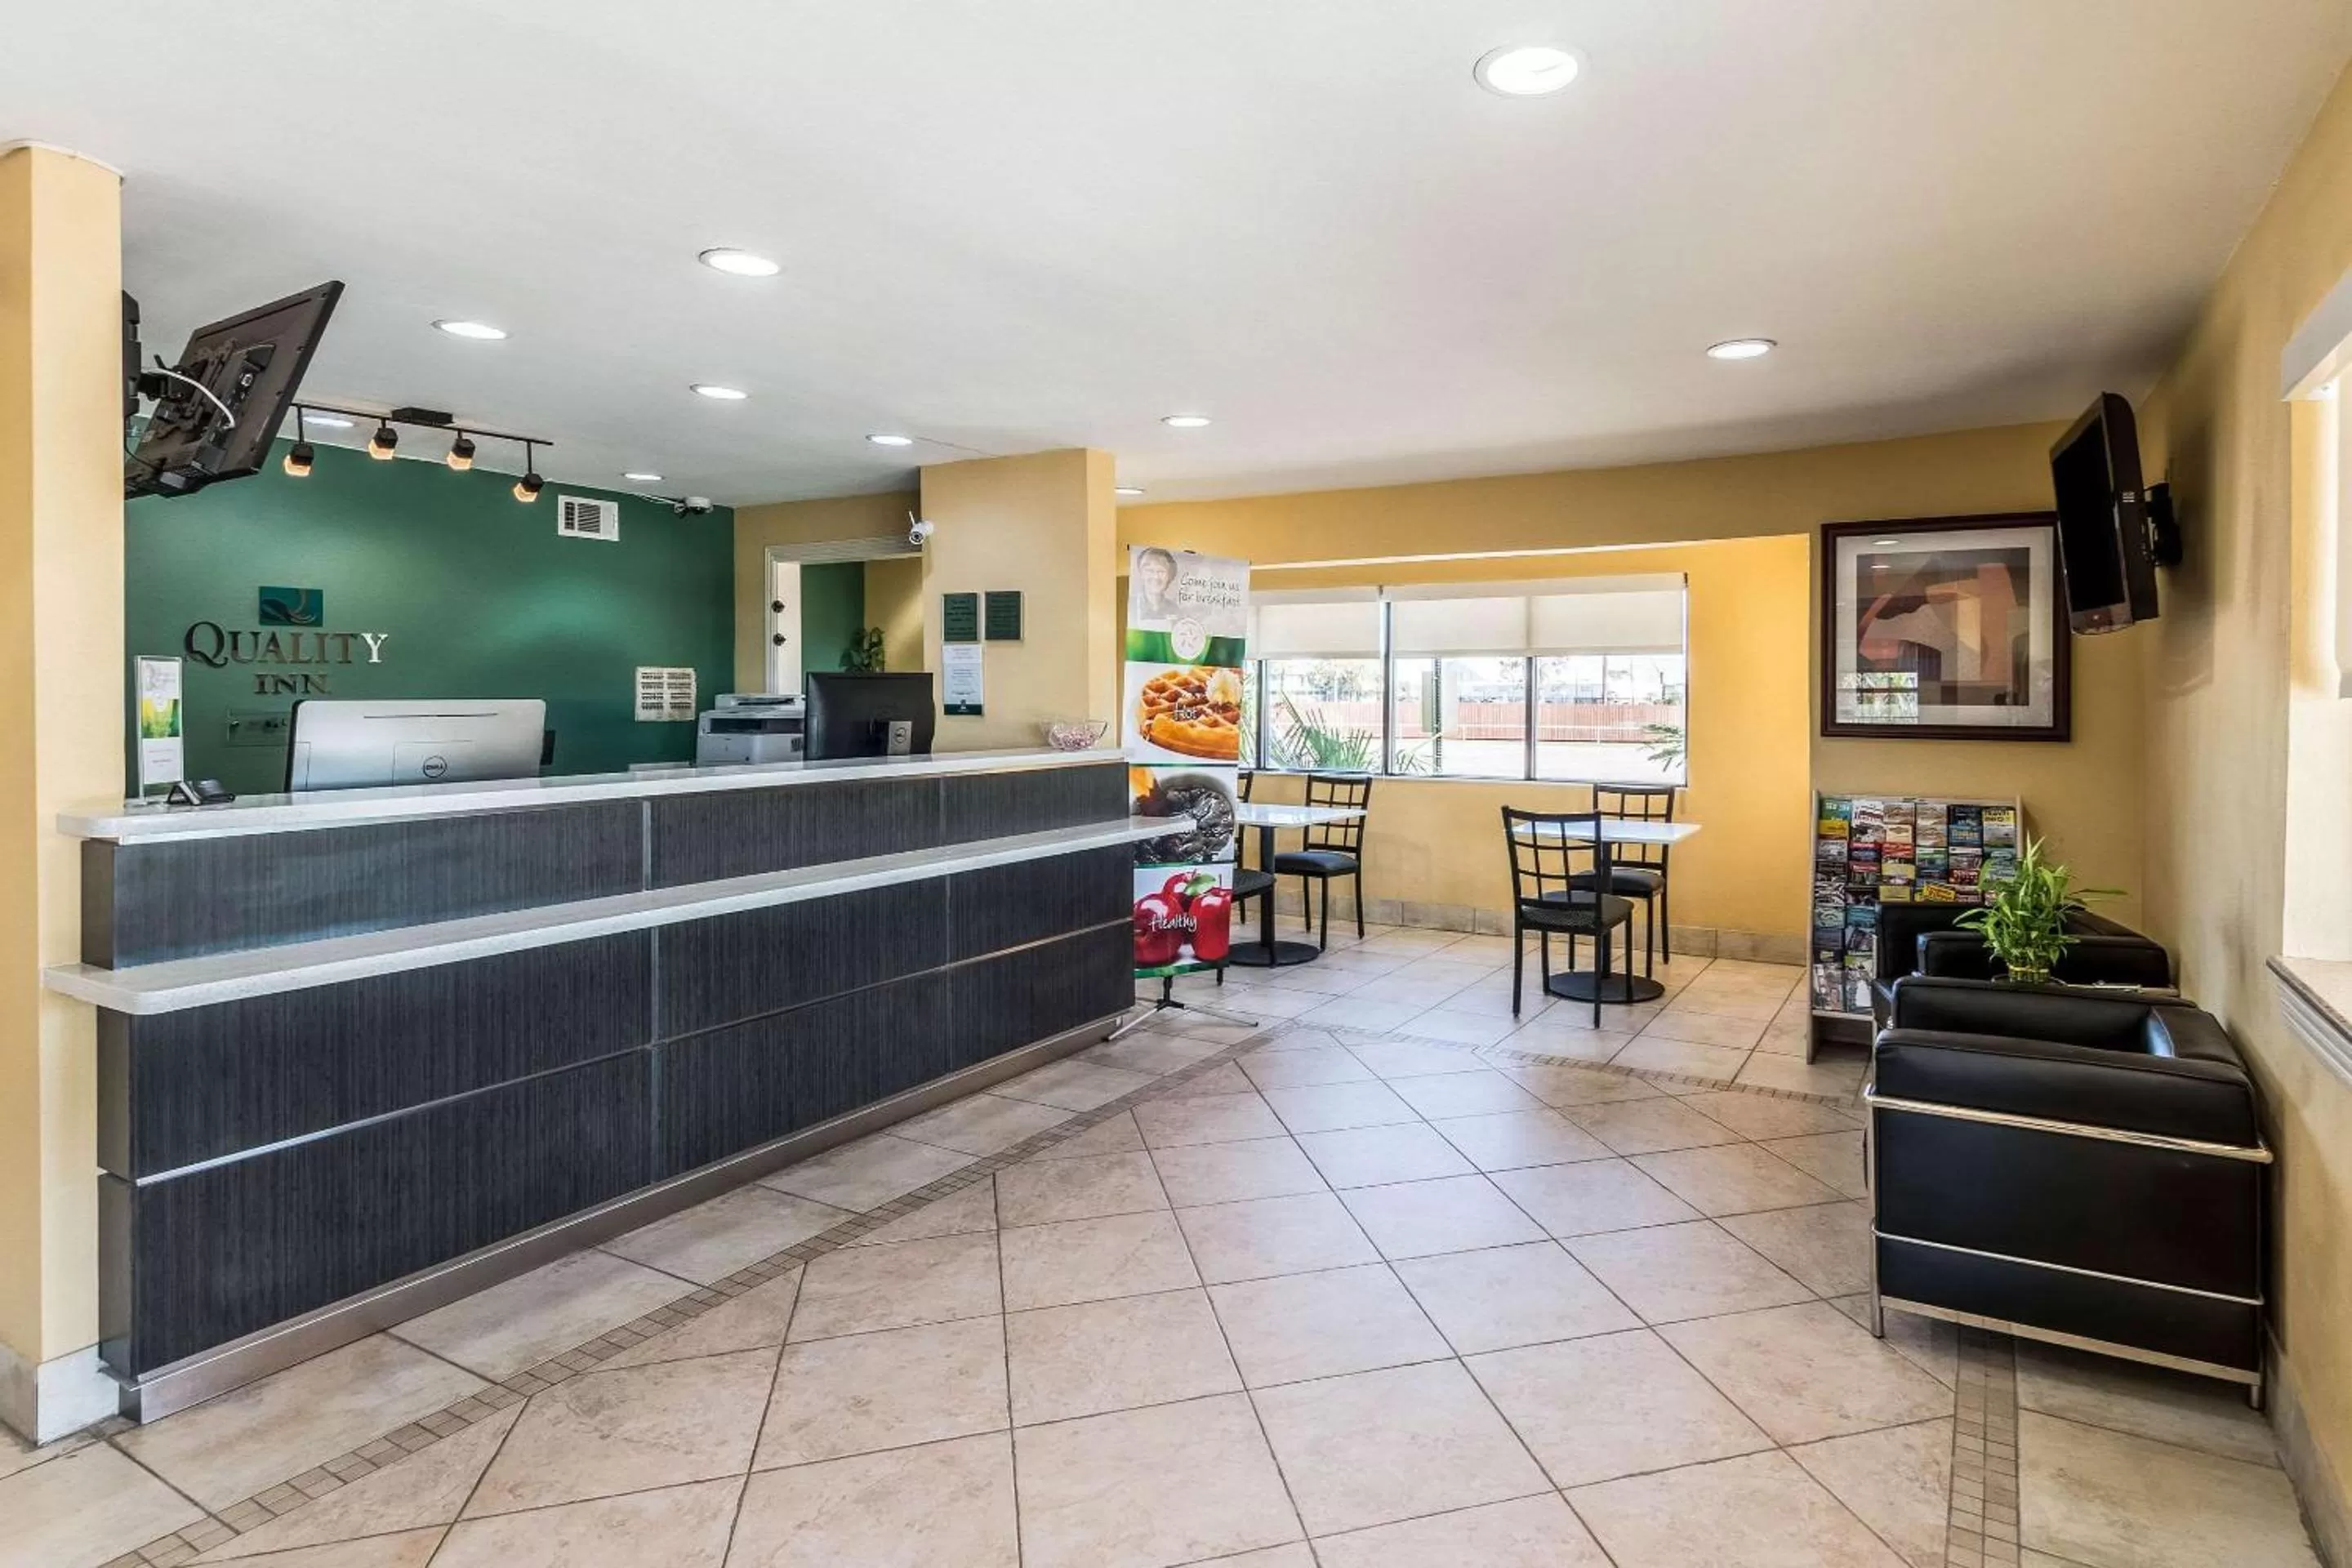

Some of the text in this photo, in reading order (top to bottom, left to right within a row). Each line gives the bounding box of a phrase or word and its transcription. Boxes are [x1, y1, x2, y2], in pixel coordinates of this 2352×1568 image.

[185, 621, 389, 668] QUALITY
[253, 674, 331, 694] INN
[1174, 702, 1198, 720] Hot
[1148, 913, 1197, 933] Healthy
